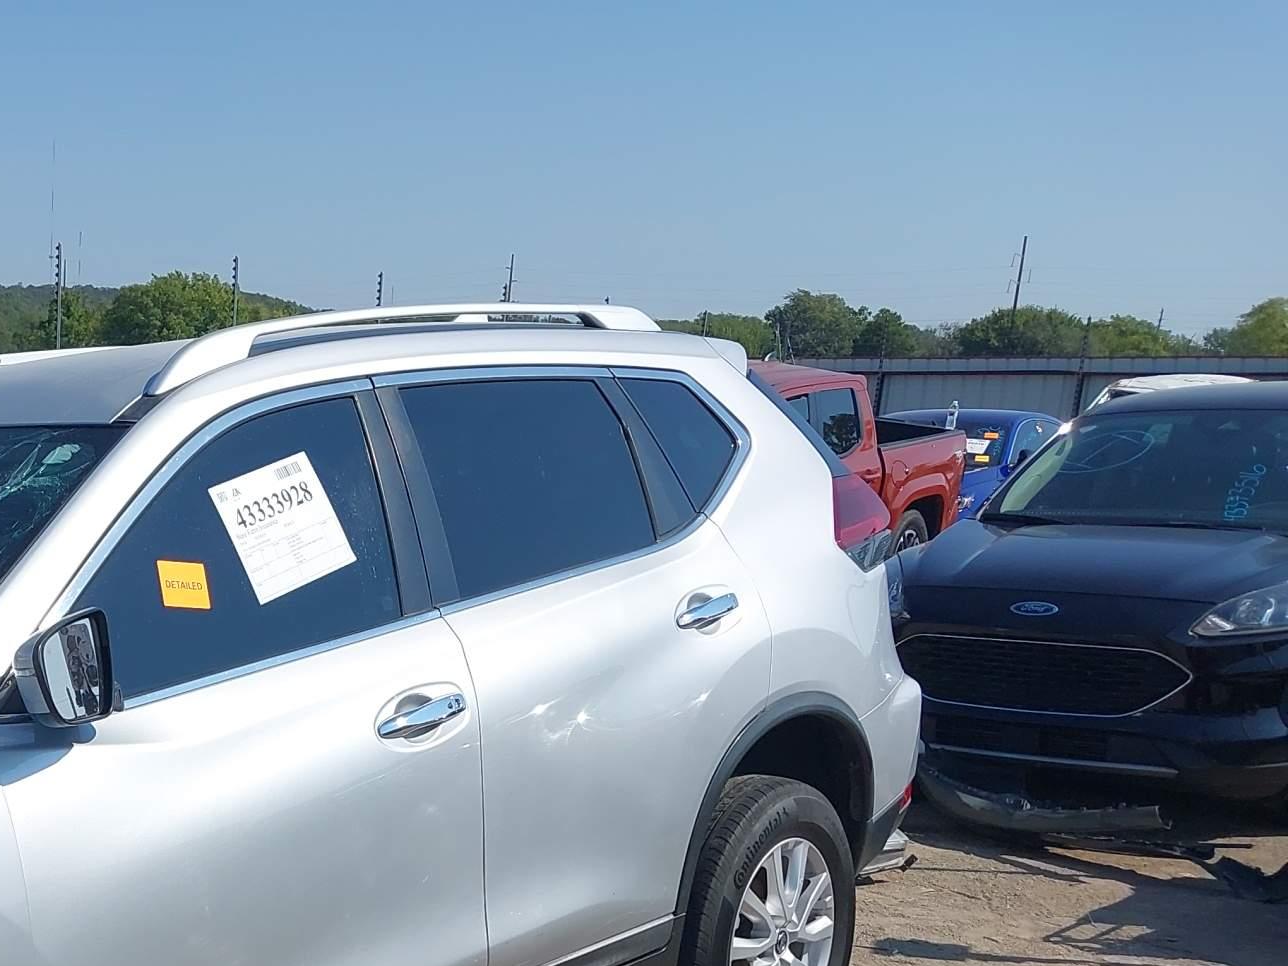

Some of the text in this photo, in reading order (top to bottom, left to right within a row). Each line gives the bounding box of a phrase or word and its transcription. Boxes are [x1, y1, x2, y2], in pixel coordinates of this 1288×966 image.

[236, 481, 313, 528] 43333928
[165, 580, 203, 591] DETAILED
[733, 810, 782, 889] Continental
